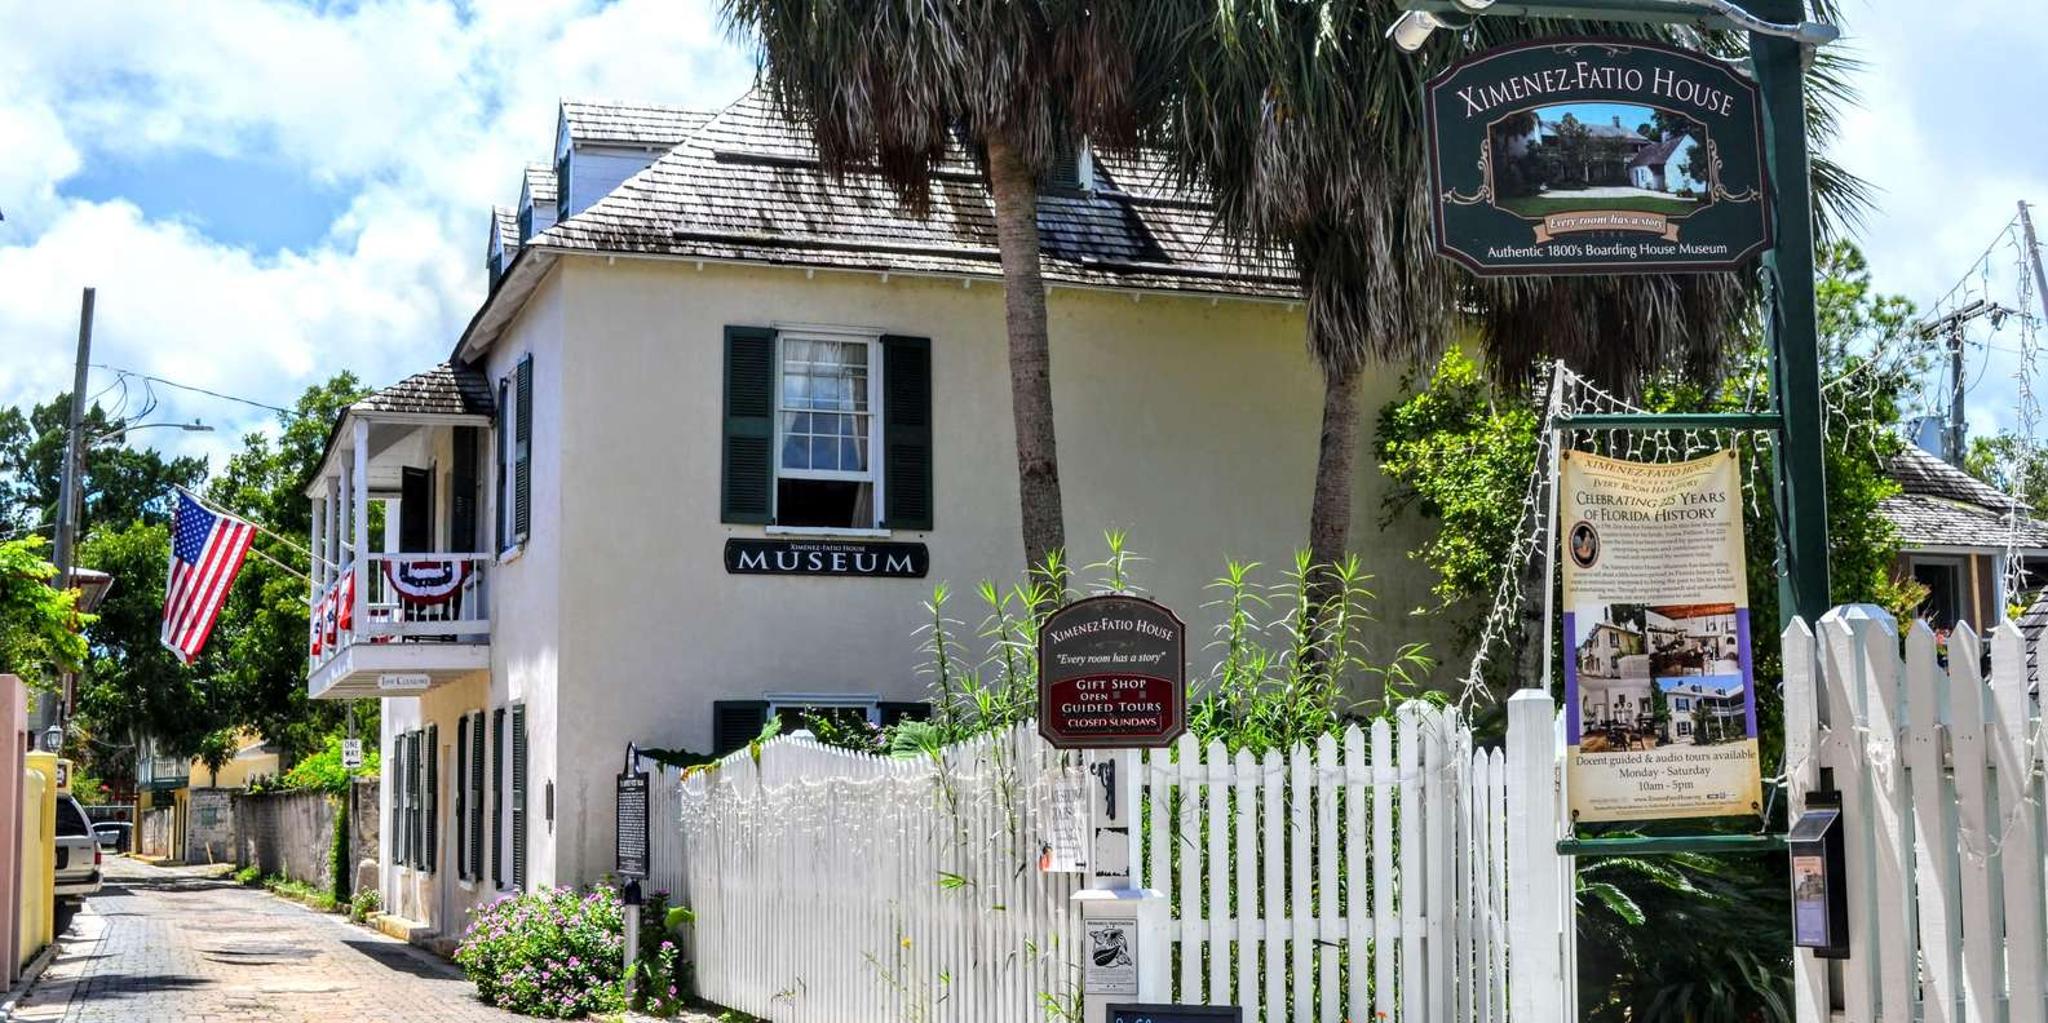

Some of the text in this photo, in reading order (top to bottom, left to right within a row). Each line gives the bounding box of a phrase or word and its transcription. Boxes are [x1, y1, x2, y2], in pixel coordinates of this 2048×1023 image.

[1457, 61, 1734, 118] XIMENEZ-FATIO HOUSE
[1550, 218, 1576, 229] Every
[1579, 216, 1607, 225] room
[1610, 214, 1629, 224] has
[1487, 243, 1727, 259] Authentic 1800's Boarding House Museum
[1584, 460, 1680, 478] XIMENEZ-FATIO
[1576, 490, 1657, 508] CELEBRATING
[1679, 491, 1726, 506] YEARS
[1584, 508, 1717, 522] OF FLORIDA HISTORY
[738, 550, 916, 573] MUSEUM
[1050, 618, 1174, 645] XIMENEZ-FATIO HOUSE
[1087, 655, 1111, 664] room
[1112, 652, 1129, 664] has
[1076, 679, 1147, 691] GIFT SHOP
[1080, 692, 1109, 701] OPEN
[1061, 702, 1162, 714] GUIDED TOURS
[1068, 717, 1158, 728] CLOSED SUNDAYS
[344, 740, 359, 749] ONE
[344, 750, 359, 758] WAY
[1576, 750, 1756, 768] Docent guided & audio tours available
[1619, 768, 1659, 780] Monday
[1667, 764, 1711, 777] Saturday
[1639, 781, 1664, 791] 10am
[1672, 780, 1694, 792] 5pm
